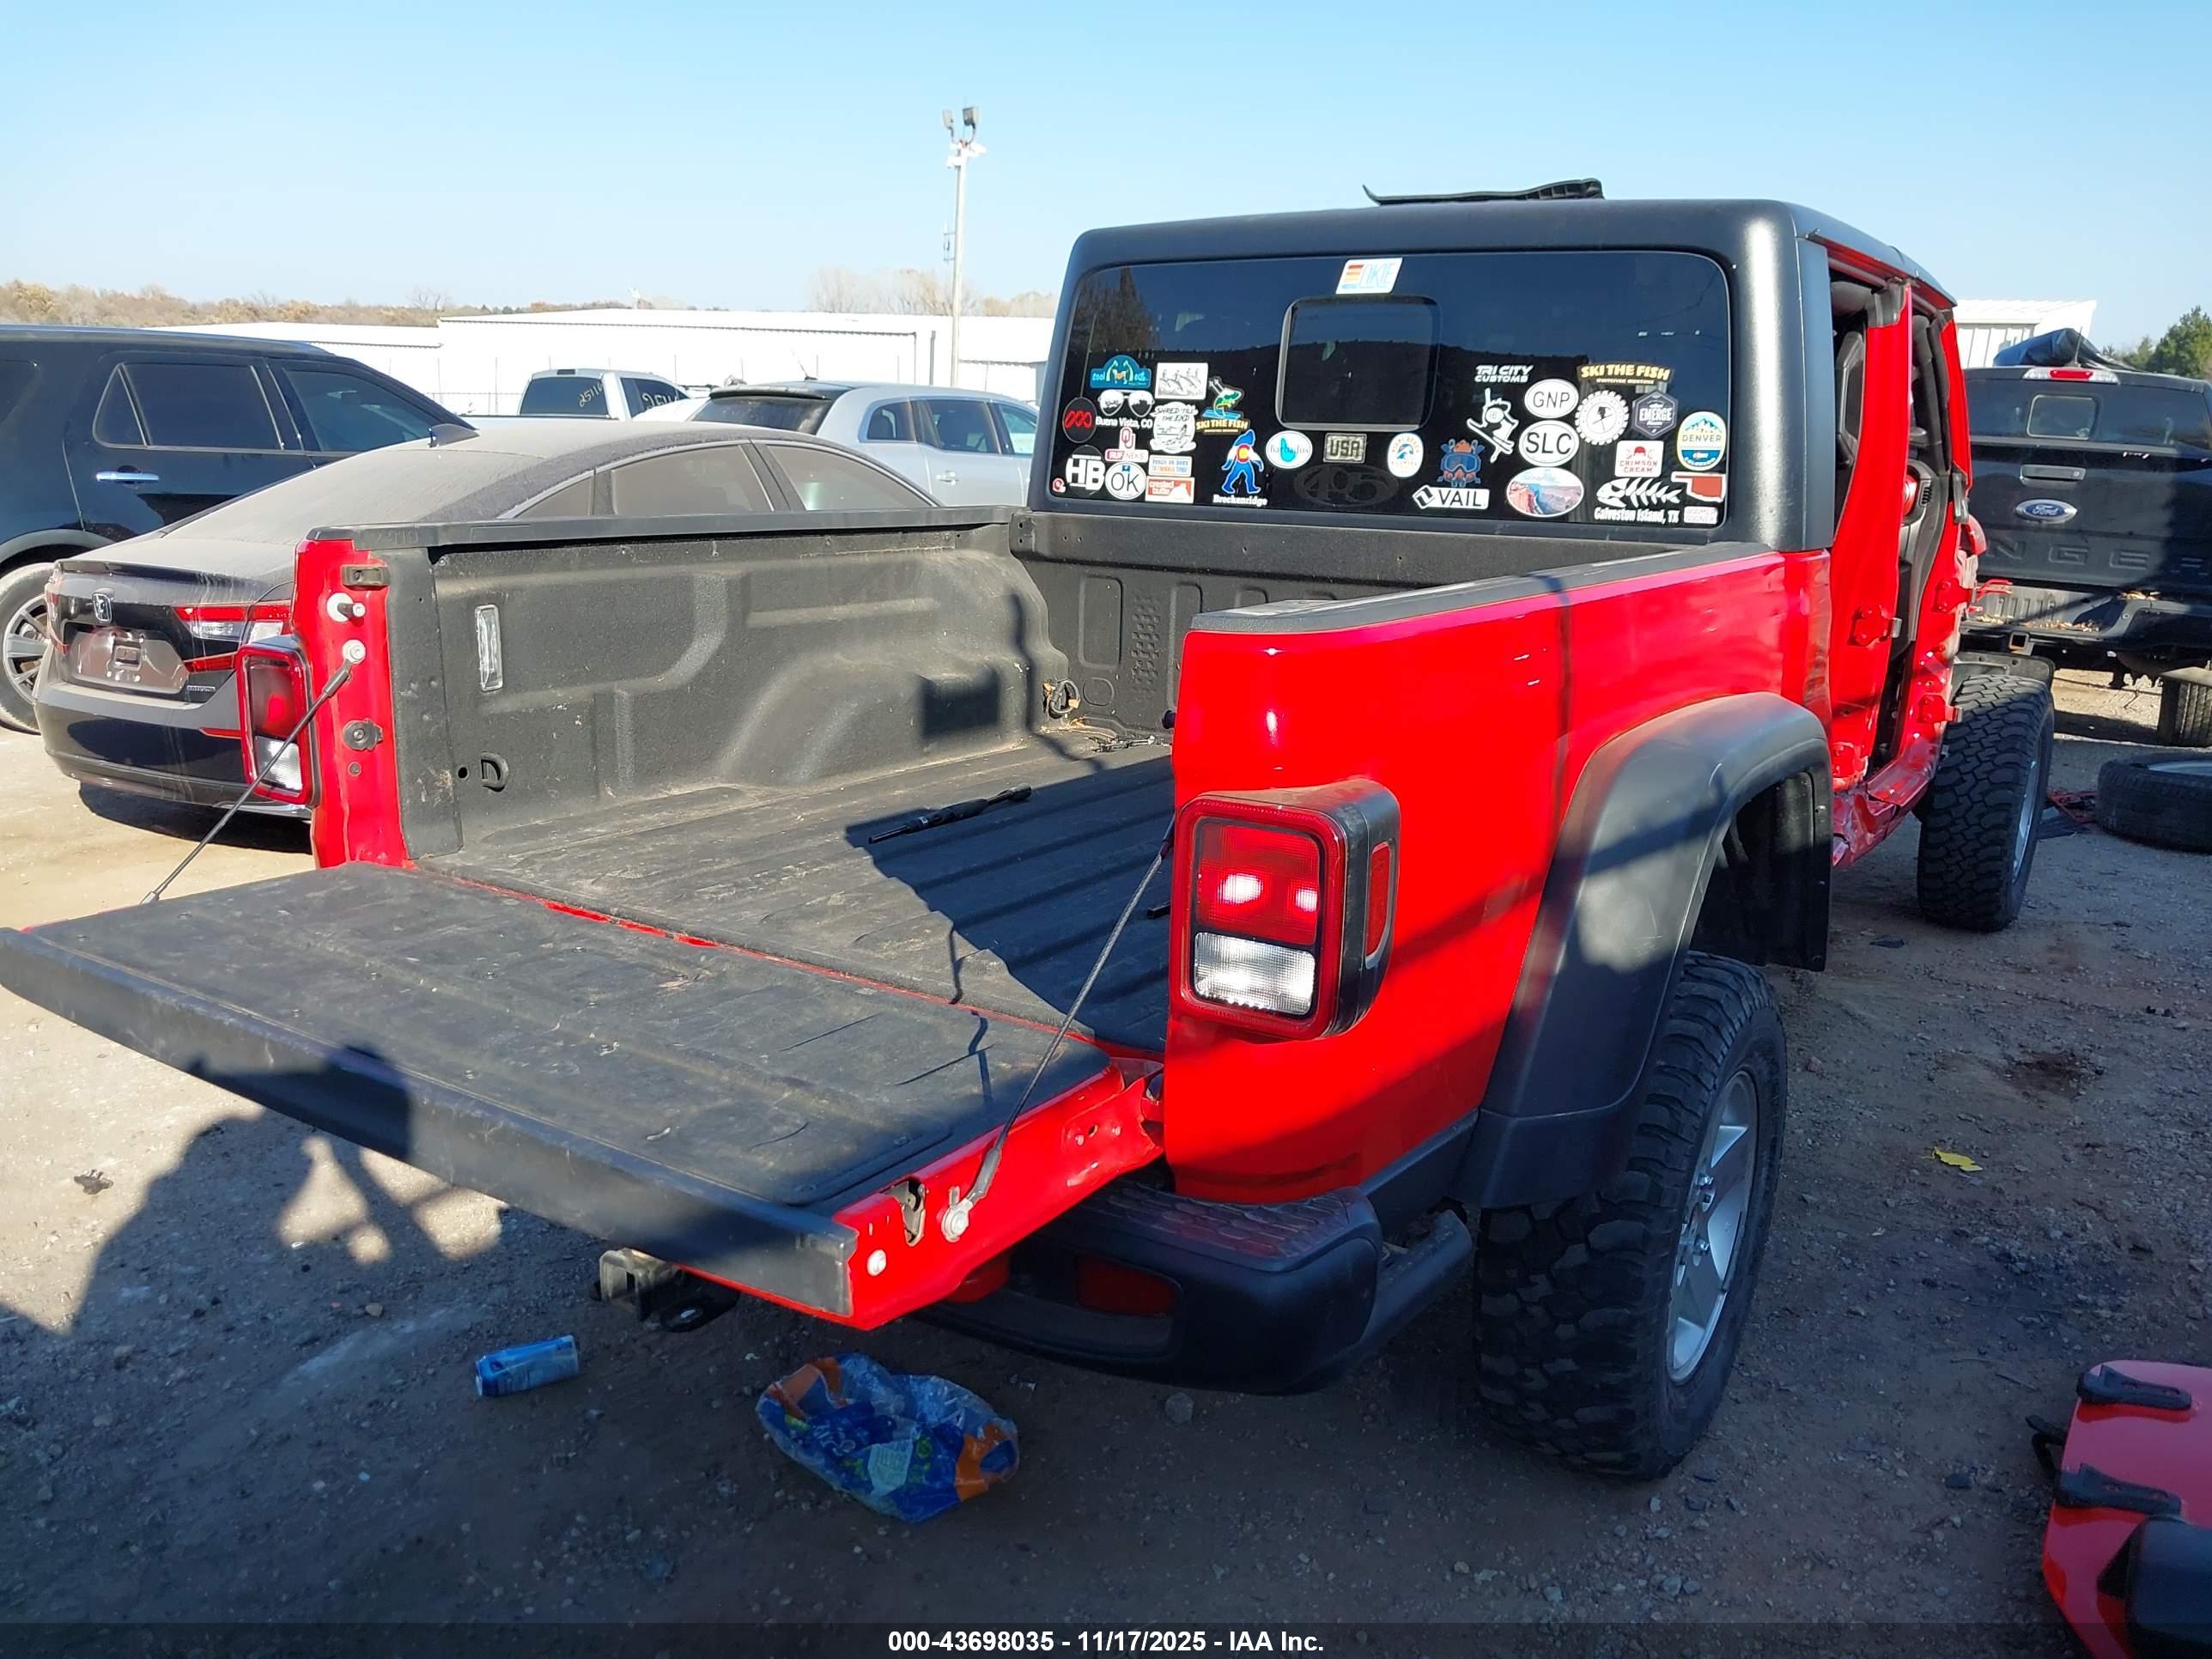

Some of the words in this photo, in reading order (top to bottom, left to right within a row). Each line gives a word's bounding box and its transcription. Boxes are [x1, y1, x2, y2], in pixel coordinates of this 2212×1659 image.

[1475, 365, 1498, 375] TRI
[1498, 365, 1534, 375] CITY
[1581, 365, 1605, 378] SKI
[1606, 364, 1635, 376] THE
[1636, 366, 1671, 380] FISH
[1474, 374, 1529, 383] CUSTOMS
[1533, 391, 1571, 409] GNP
[1639, 407, 1673, 422] EMERGE
[1096, 416, 1118, 426] Buena
[1119, 417, 1140, 429] Vista,
[1140, 418, 1153, 428] CO
[1195, 420, 1210, 430] SKI
[1211, 419, 1228, 428] THE
[1228, 420, 1249, 430] FISH
[1525, 431, 1572, 455] SLC
[1682, 434, 1723, 442] DENVER
[1330, 440, 1361, 458] USA
[1066, 458, 1106, 490] HB
[1110, 472, 1140, 493] OK
[1212, 494, 1268, 507] Breckenridge
[1438, 489, 1482, 507] VAIL
[1594, 507, 1637, 521] Galveston
[1636, 508, 1666, 525] Island,
[1667, 510, 1680, 524] TX
[2032, 504, 2059, 516] Ford
